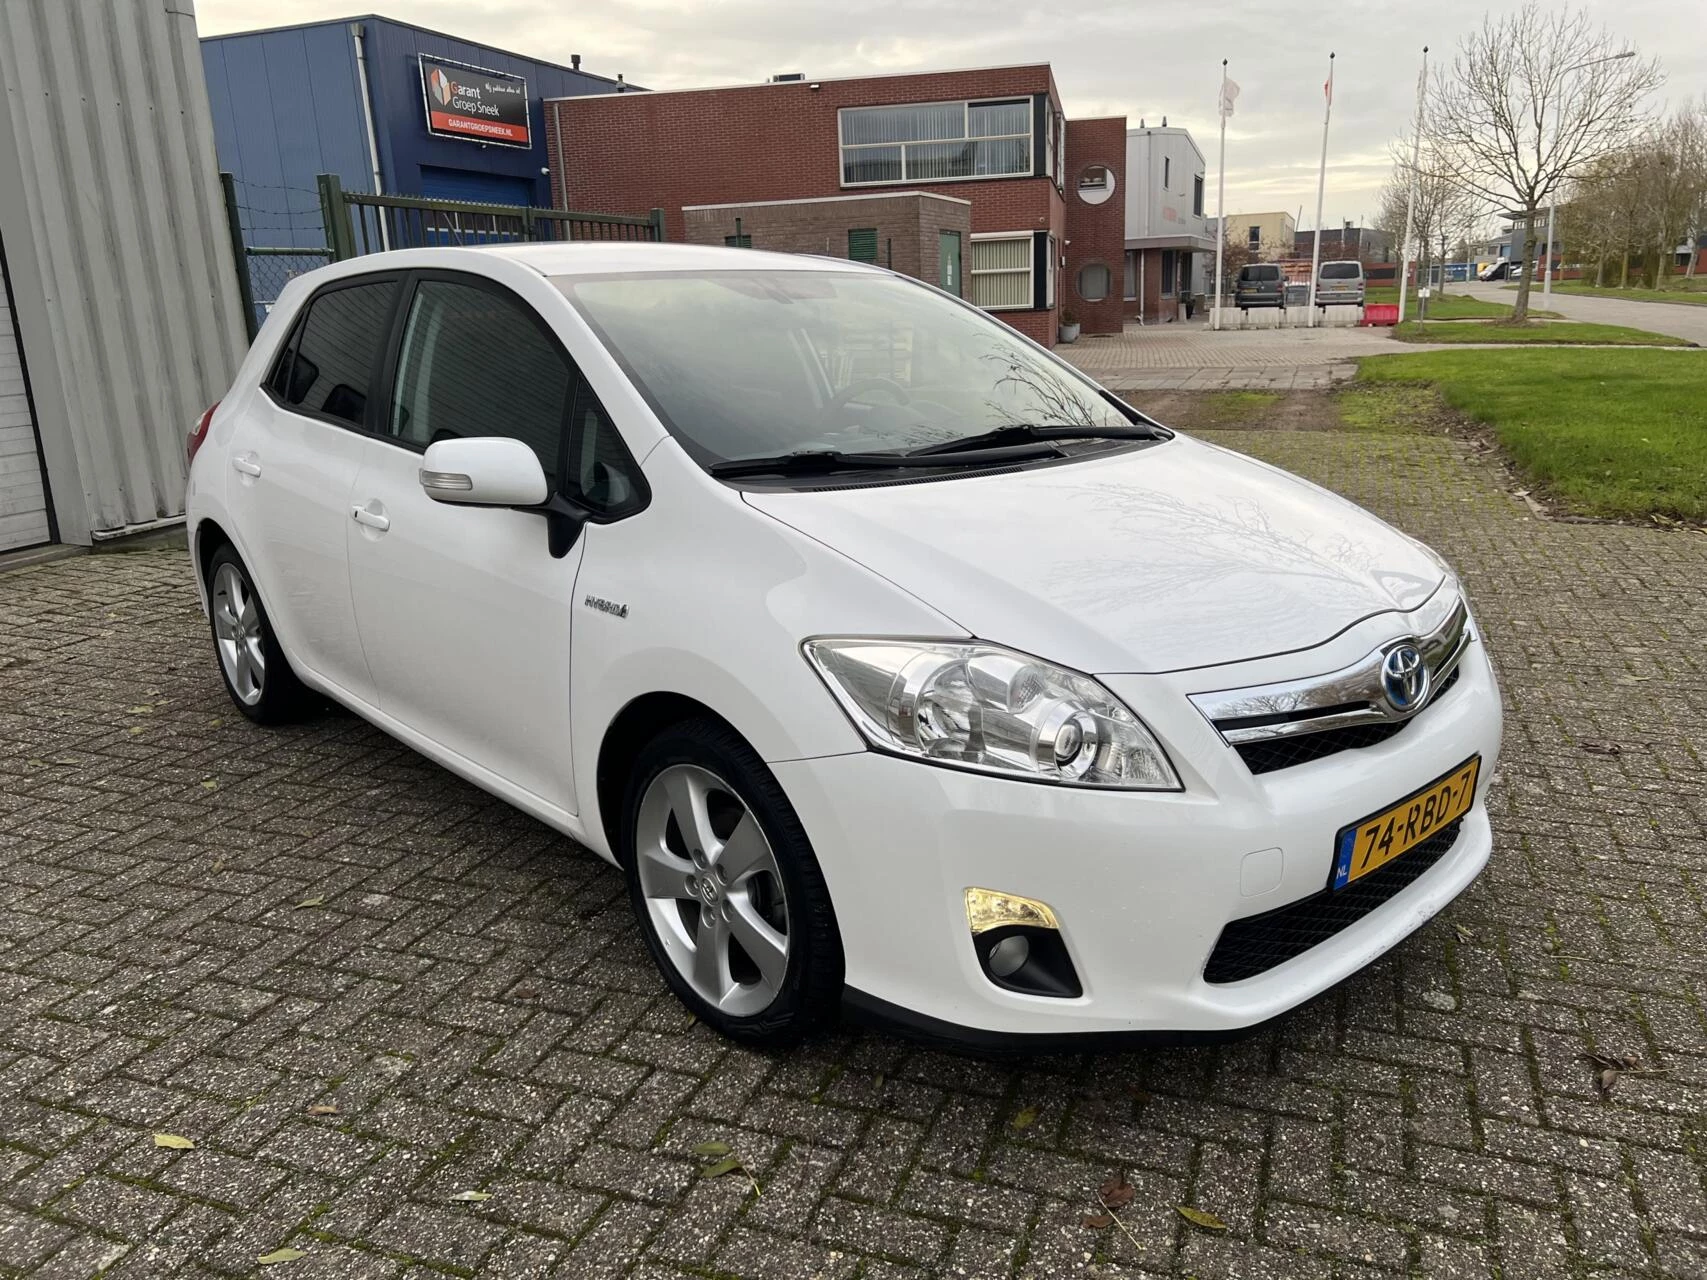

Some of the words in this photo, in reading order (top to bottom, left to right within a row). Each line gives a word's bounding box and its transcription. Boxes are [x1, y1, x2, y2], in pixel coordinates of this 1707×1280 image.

[451, 81, 481, 99] Garant
[452, 96, 477, 114] Groep
[478, 101, 500, 116] Sneek
[448, 118, 513, 136] GARANTGROEPSNEEK.NL
[1360, 770, 1472, 869] 74-RBD-7
[1336, 865, 1348, 879] NL
